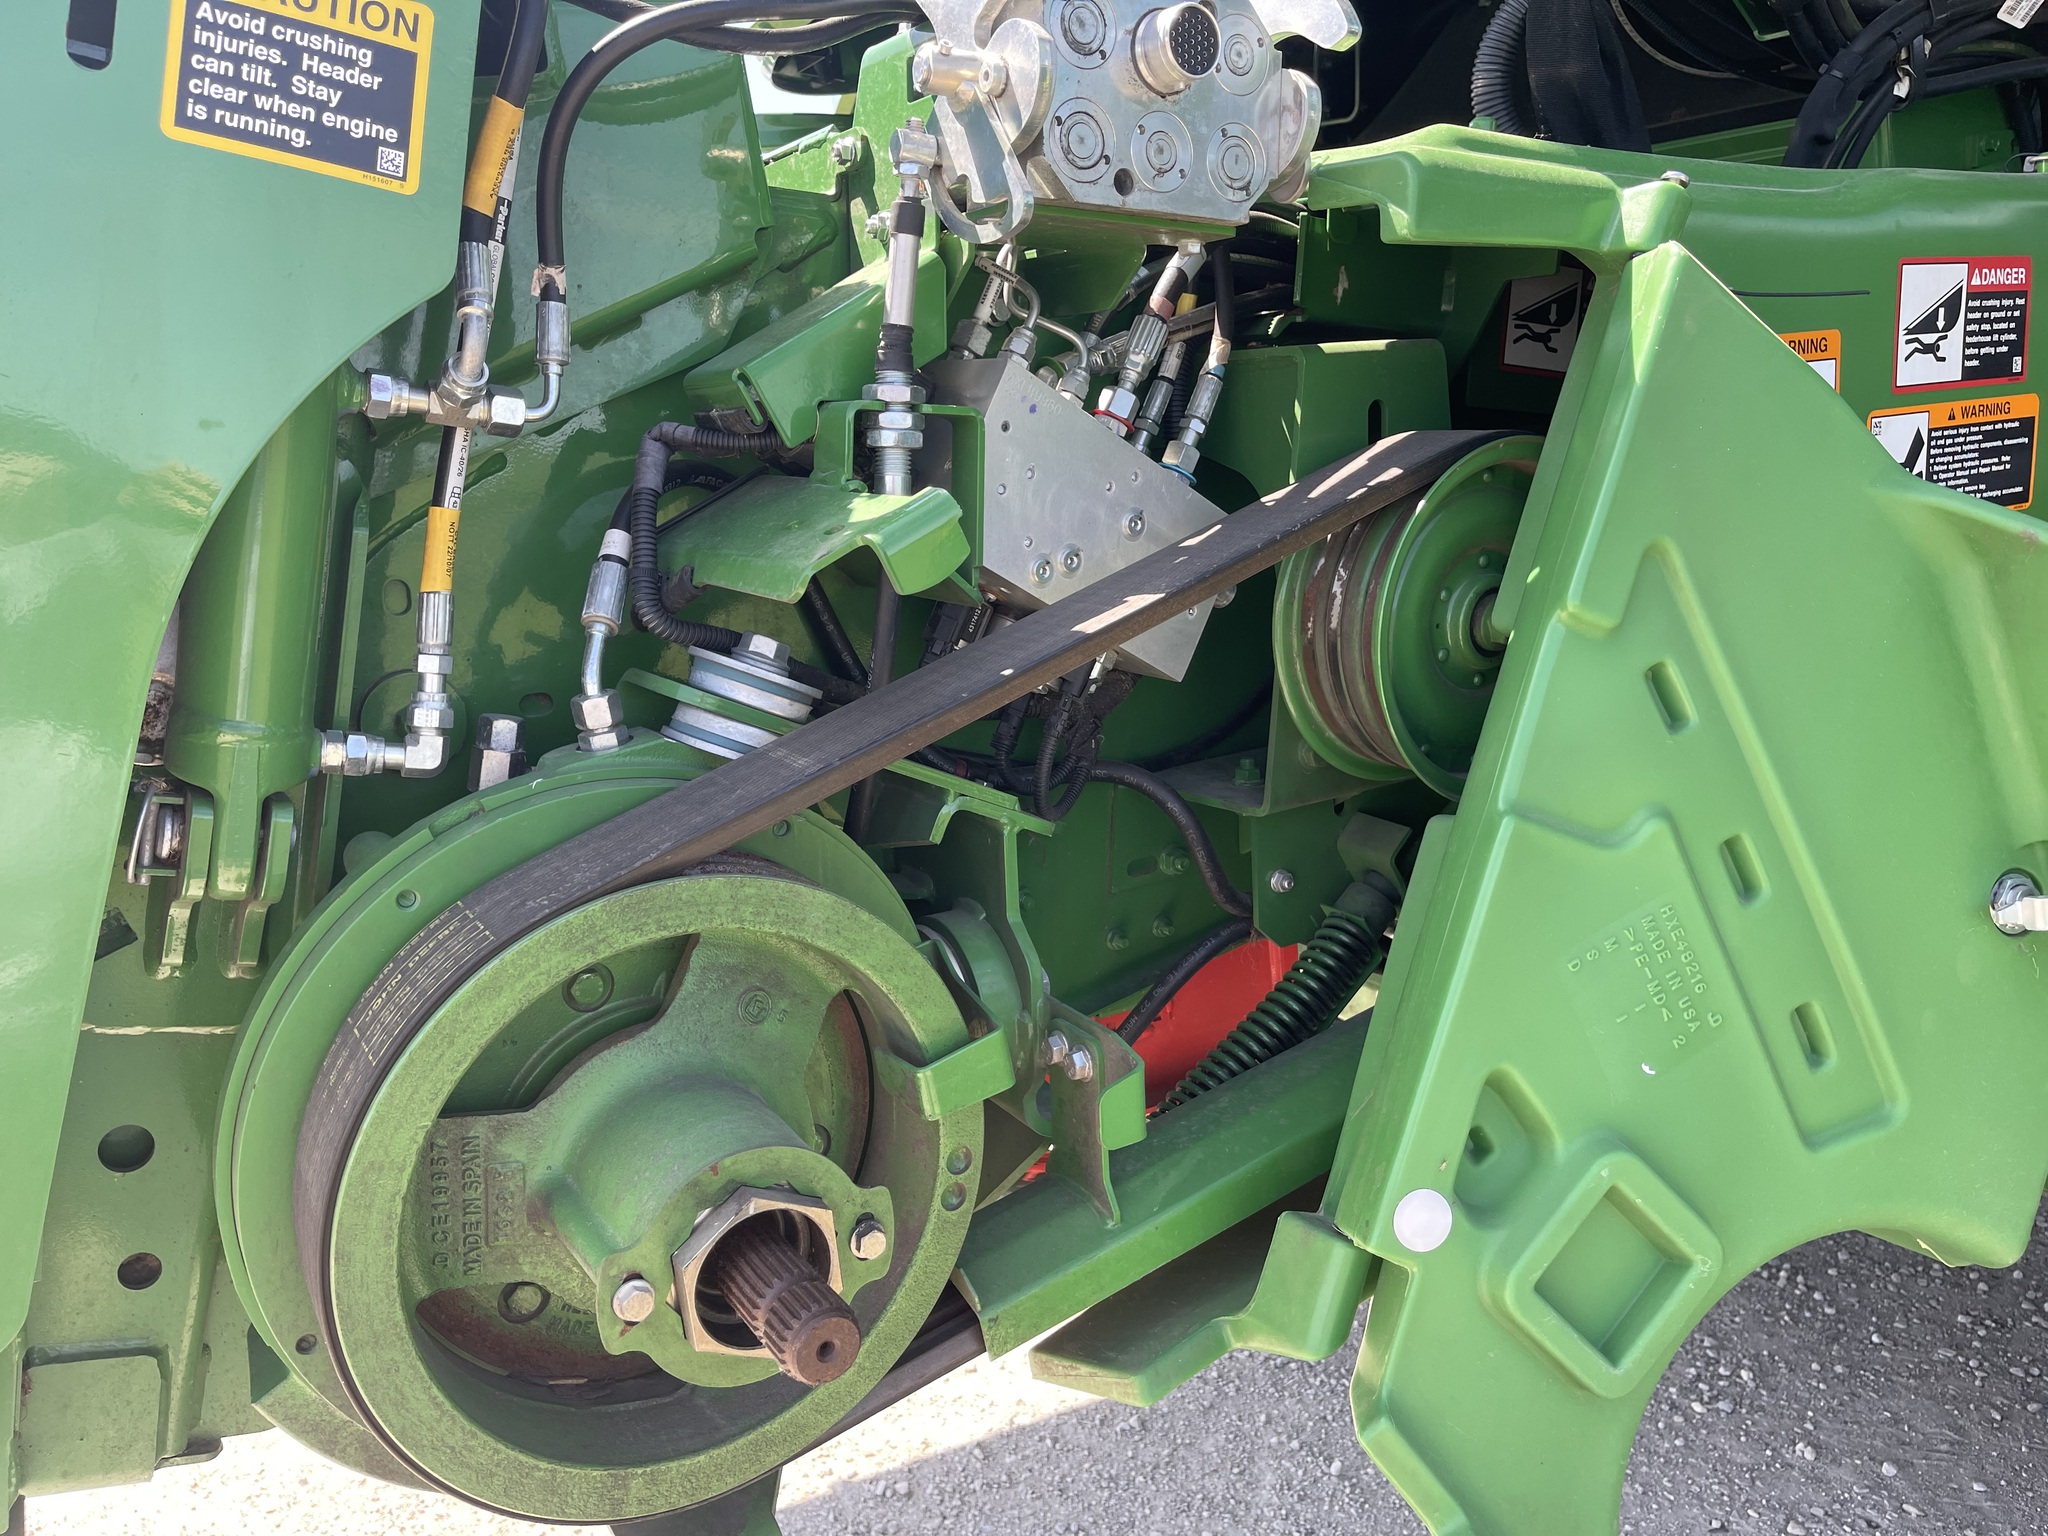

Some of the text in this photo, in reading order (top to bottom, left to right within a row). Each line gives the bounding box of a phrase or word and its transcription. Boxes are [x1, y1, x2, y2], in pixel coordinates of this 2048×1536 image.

[193, 24, 383, 91] injuries. Header
[195, 1, 373, 68] Avoid crushing
[190, 53, 342, 108] can tilt. Stay
[186, 98, 312, 148] is running.
[188, 77, 398, 143] clear when engine
[362, 173, 394, 186] H151607
[494, 199, 510, 243] Parker
[1981, 267, 2026, 285] DANGER
[1787, 336, 1828, 355] RNING
[1961, 402, 2011, 419] WARNING
[1641, 914, 1701, 1033] MADE IN USA
[1660, 904, 1708, 994] HXE48216
[461, 1135, 482, 1276] MADE IN SPAIN
